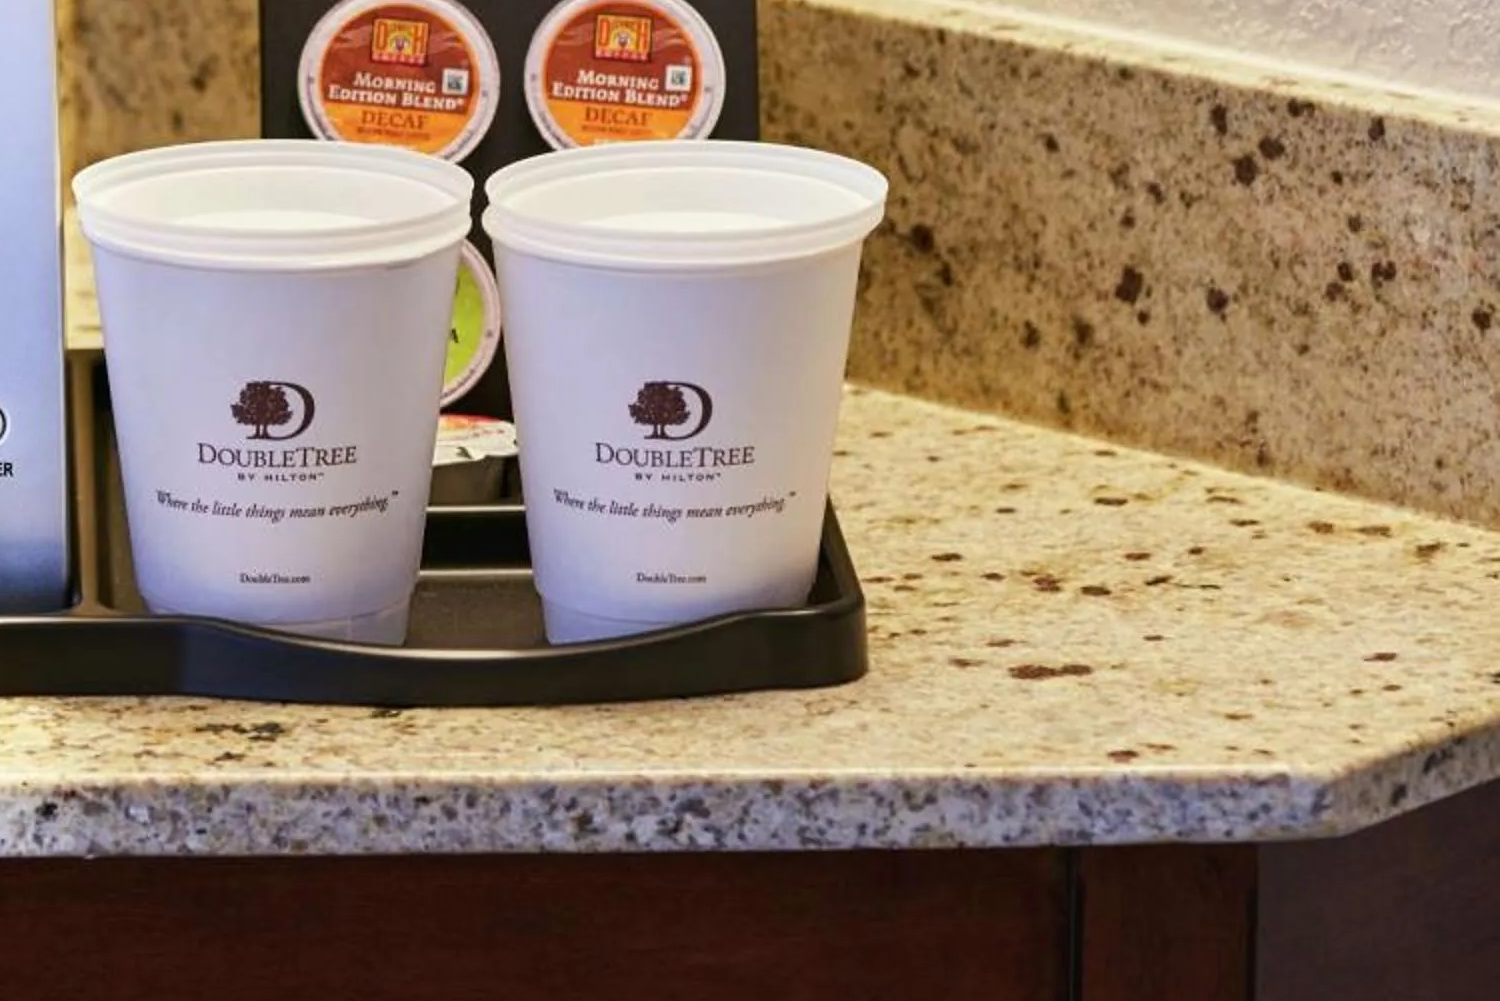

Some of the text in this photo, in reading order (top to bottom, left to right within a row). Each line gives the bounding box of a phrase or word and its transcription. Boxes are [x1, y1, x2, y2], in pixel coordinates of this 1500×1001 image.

[352, 71, 437, 94] MORNING
[577, 68, 659, 91] MORNING
[328, 83, 398, 104] EDITION
[552, 80, 620, 103] EDITION
[361, 108, 428, 130] DECAF
[584, 106, 653, 126] DECAF
[237, 473, 256, 481] BY
[635, 473, 653, 481] BY
[156, 489, 188, 510] Where
[191, 499, 208, 515] the
[211, 500, 242, 518] little
[245, 502, 285, 523] things
[289, 506, 325, 518] mean
[553, 488, 585, 510] Where
[587, 498, 605, 514] the
[609, 500, 640, 518] little
[642, 503, 682, 523] things
[686, 507, 722, 518] mean
[239, 573, 311, 584] DoubleTree.com
[636, 573, 707, 584] DoubleTree.com
